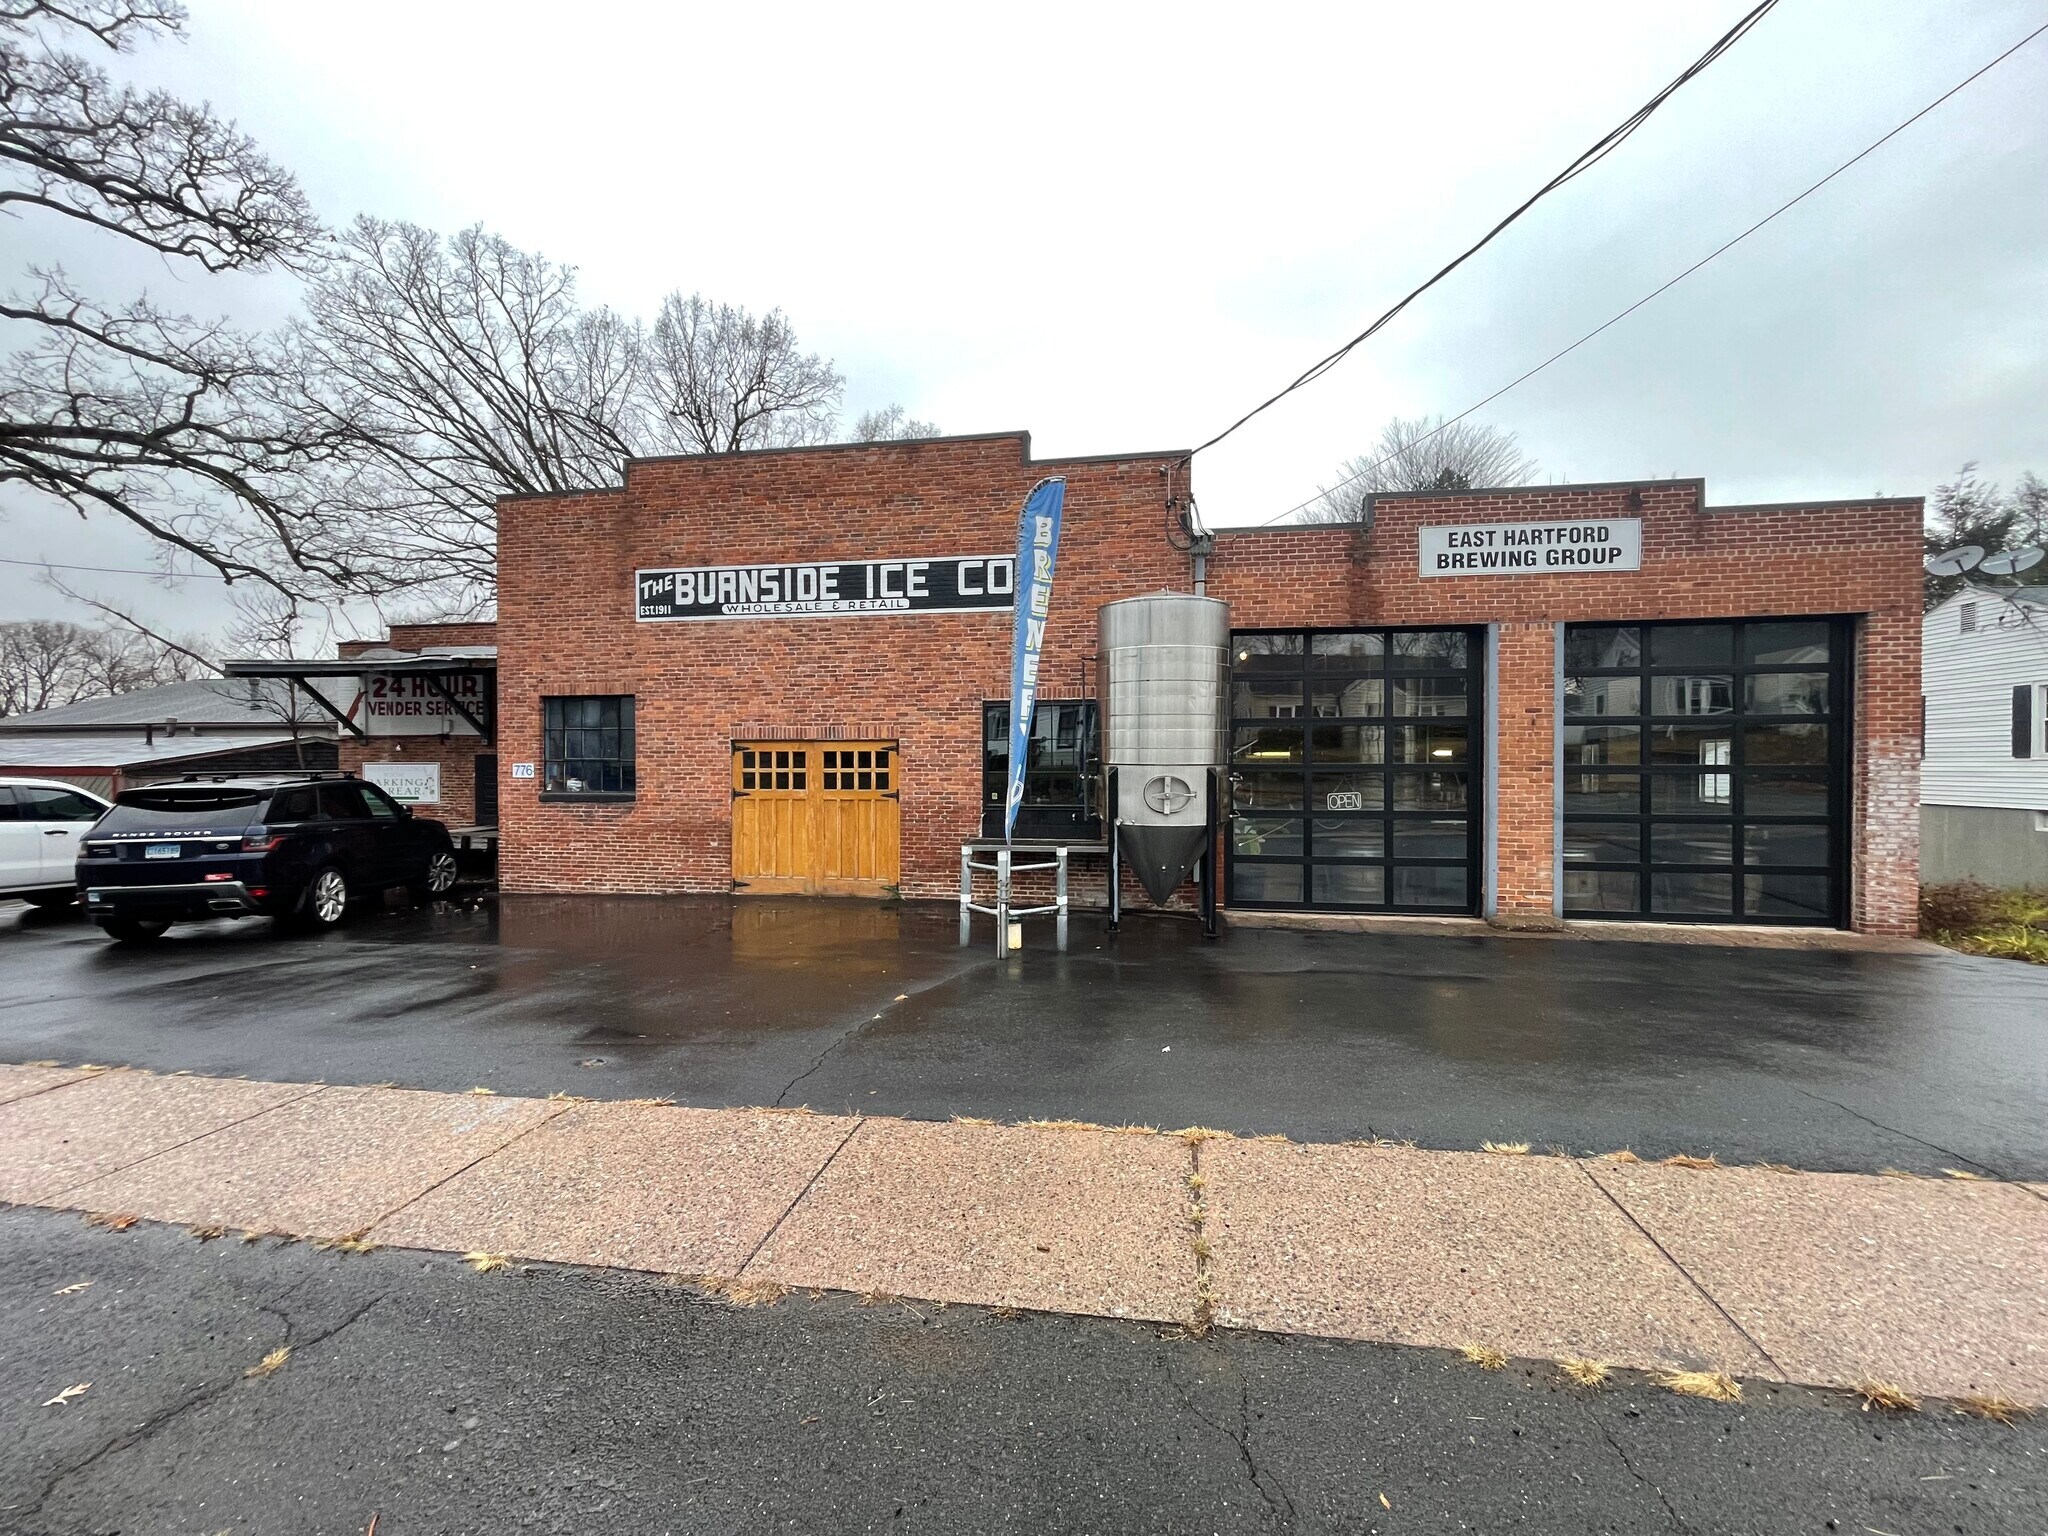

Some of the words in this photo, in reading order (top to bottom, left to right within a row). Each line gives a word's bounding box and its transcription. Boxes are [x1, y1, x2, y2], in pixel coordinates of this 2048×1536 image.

[1448, 531, 1496, 548] EAST
[1504, 526, 1609, 546] HARTFORD
[1437, 550, 1537, 569] BREWING
[1545, 547, 1622, 566] GROUP
[640, 574, 674, 600] THE
[675, 566, 840, 606] BURNSIDE
[866, 563, 930, 599] ICE
[957, 559, 1014, 596] CO
[640, 605, 672, 616] EST.1911
[726, 601, 823, 614] WHOLESALE
[848, 599, 905, 610] RETAIL
[371, 677, 406, 698] 24
[367, 701, 422, 716] VENDER
[513, 764, 533, 776] 776
[388, 787, 422, 796] REAR
[1329, 794, 1360, 809] OPEN
